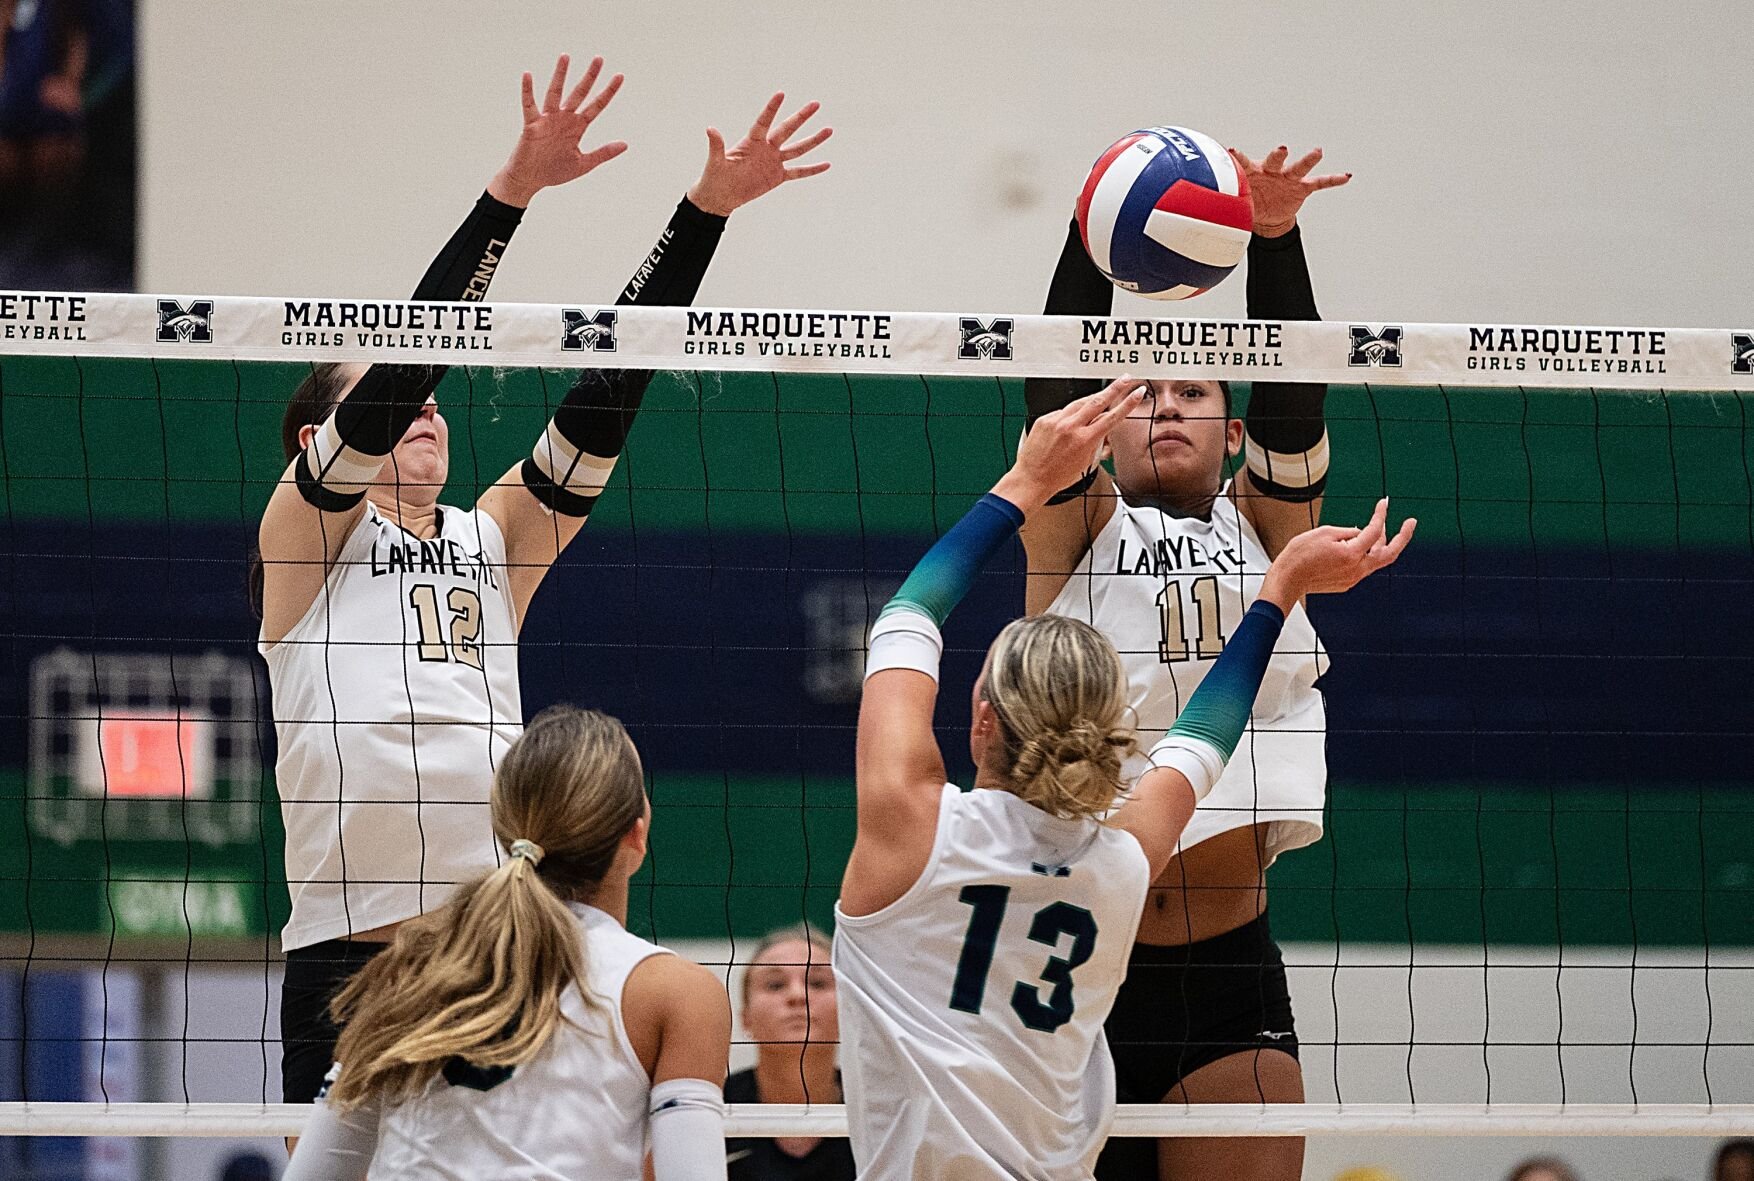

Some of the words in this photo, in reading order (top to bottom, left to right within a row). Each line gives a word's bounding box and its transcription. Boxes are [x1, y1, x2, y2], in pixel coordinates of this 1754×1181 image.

[625, 228, 675, 302] LAFAYETTE
[284, 302, 492, 332] MARQUETTE
[686, 311, 891, 341] MARQUETTE
[0, 324, 87, 341] EYBALL
[281, 331, 344, 347] GIRLS
[357, 333, 493, 350] VOLLEYBALL
[1081, 320, 1282, 349] MARQUETTE
[1469, 327, 1666, 357] MARQUETTE
[684, 341, 745, 356] GIRLS
[758, 342, 891, 359] VOLLEYBALL
[1079, 349, 1139, 364] GIRLS
[1152, 350, 1283, 367] VOLLEYBALL
[1467, 356, 1526, 371] GIRLS
[1538, 357, 1667, 374] VOLLEYBALL
[409, 584, 485, 671] 12
[1155, 576, 1226, 664] 11
[948, 884, 1099, 1034] 13
